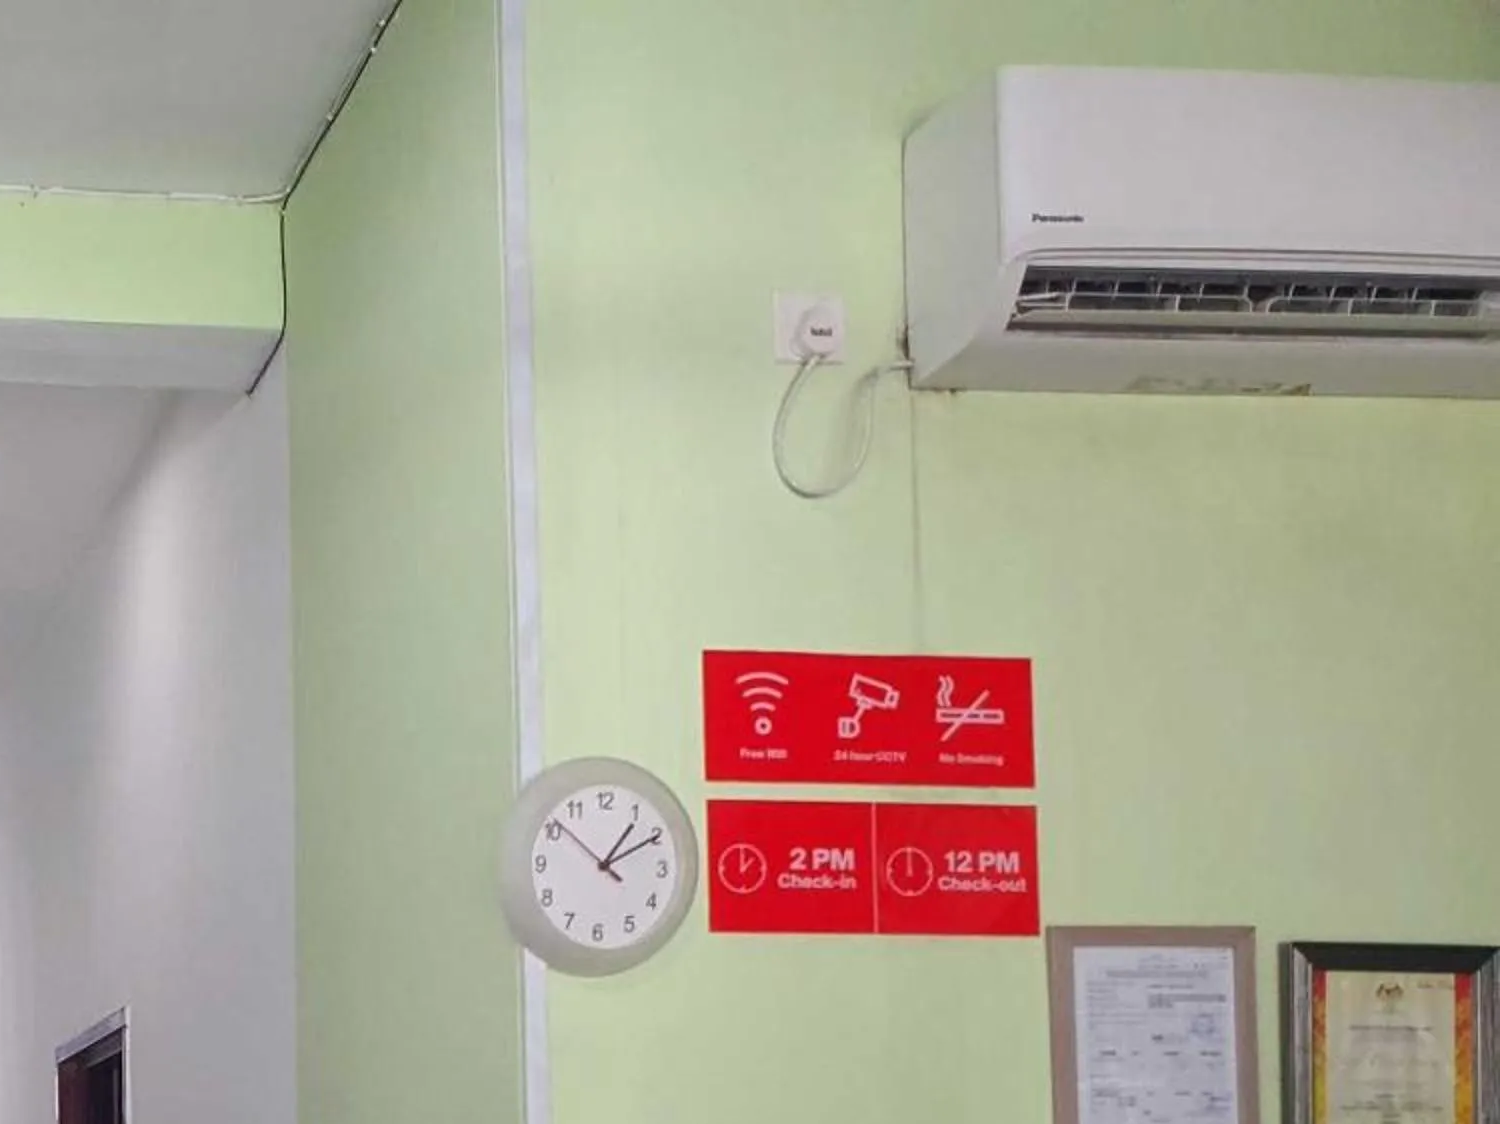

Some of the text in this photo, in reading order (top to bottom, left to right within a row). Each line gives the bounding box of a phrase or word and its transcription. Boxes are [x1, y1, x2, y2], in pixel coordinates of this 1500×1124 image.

[566, 799, 584, 820] 11
[596, 791, 615, 811] 12
[631, 803, 640, 822] 1
[534, 855, 547, 873] 9
[789, 847, 856, 872] 2 PM
[943, 851, 1020, 874] 12 PM
[656, 861, 669, 879] 3
[777, 872, 857, 890] Check-in
[937, 875, 1027, 894] Check-out
[541, 889, 553, 907] 8
[645, 893, 658, 911] 4
[564, 912, 576, 930] 7
[624, 915, 636, 933] 5
[592, 923, 604, 942] 6
